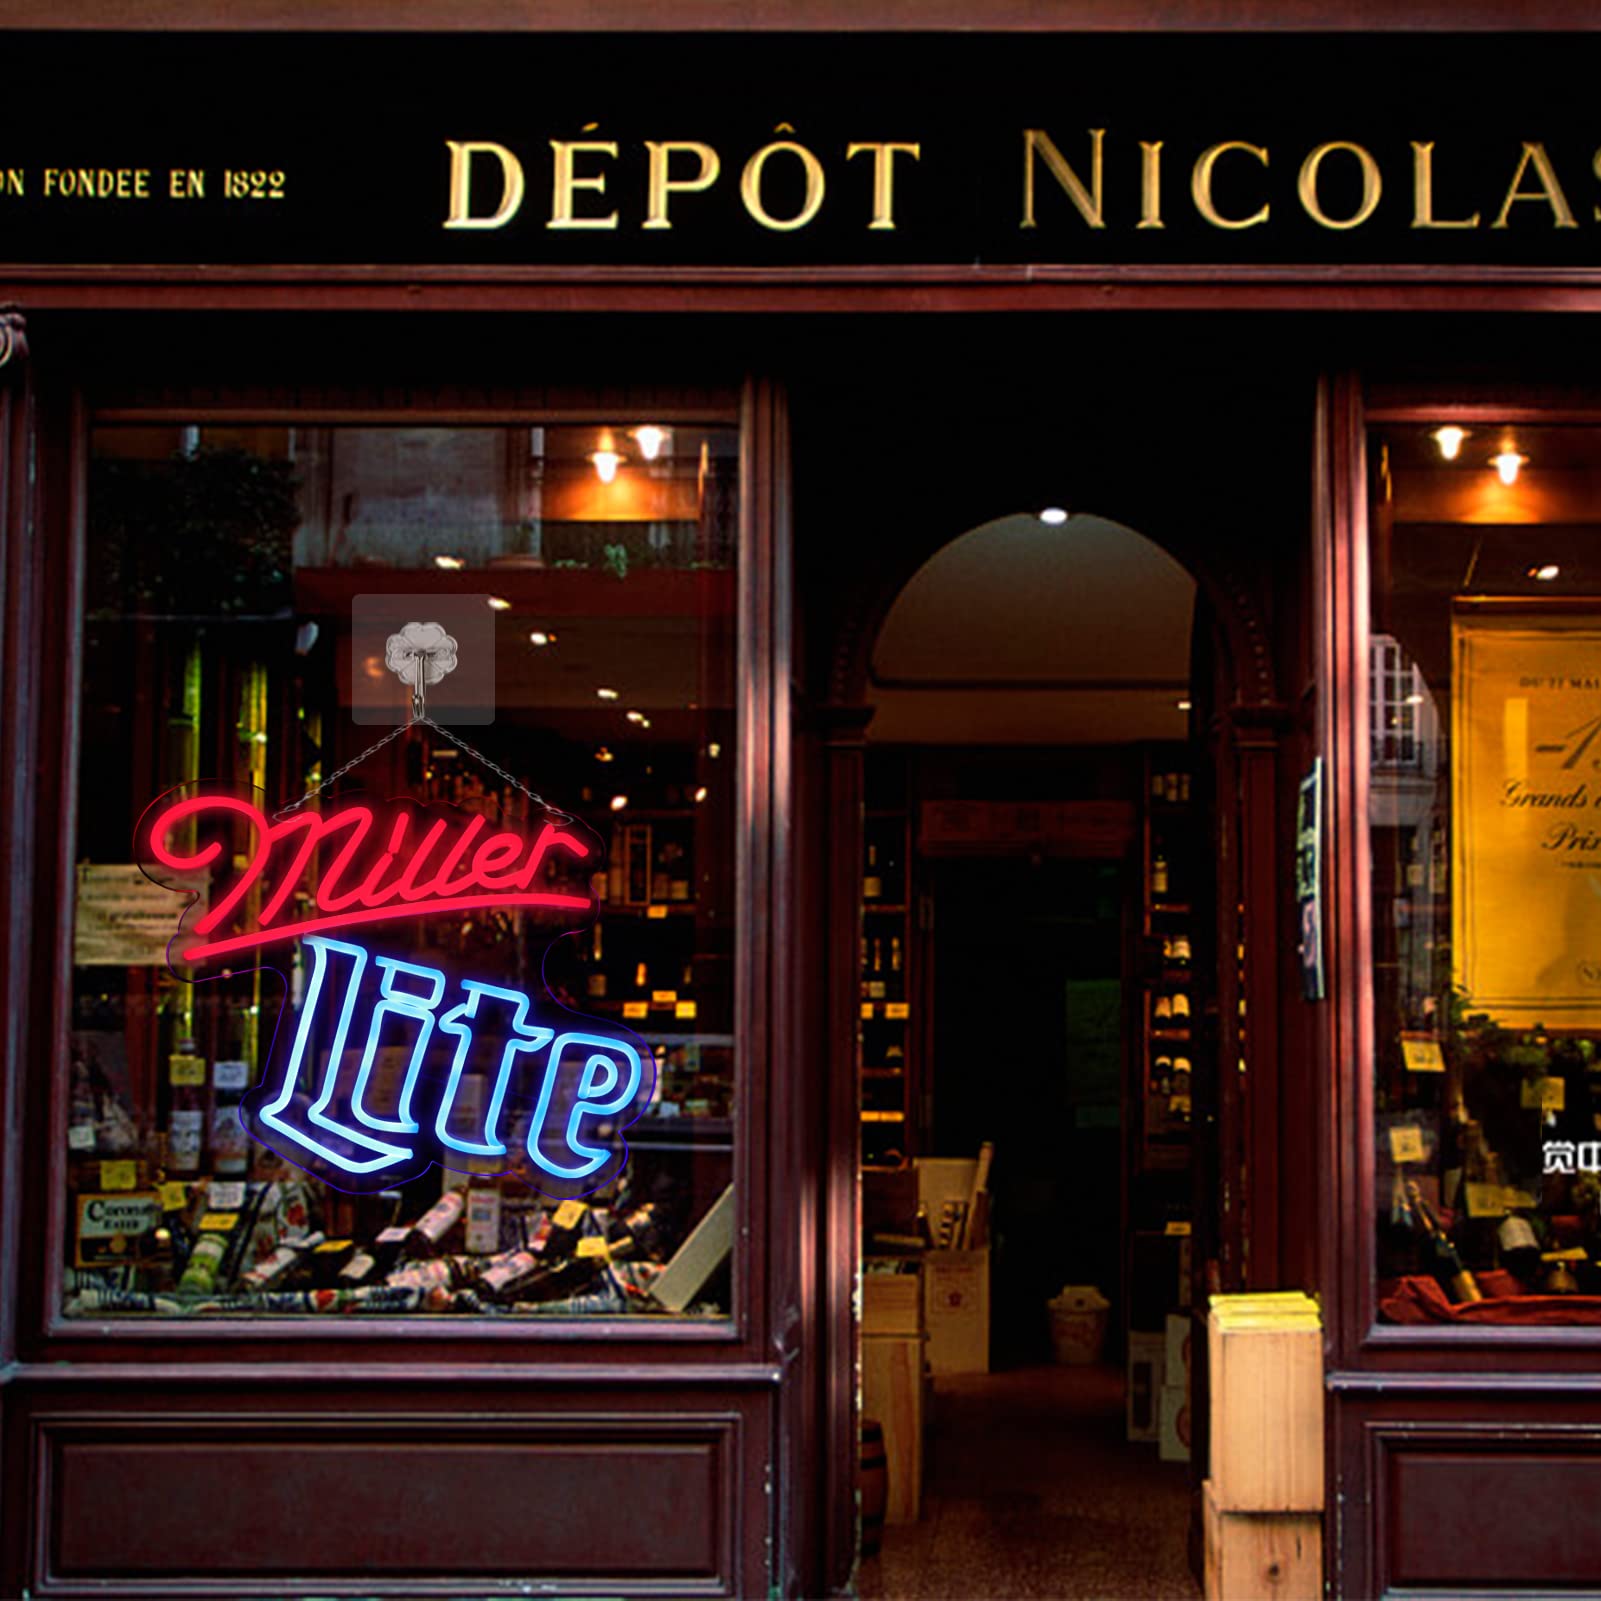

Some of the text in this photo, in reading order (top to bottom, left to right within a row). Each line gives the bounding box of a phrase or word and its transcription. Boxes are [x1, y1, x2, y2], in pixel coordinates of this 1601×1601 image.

[0, 169, 286, 198] N FONDEE EN 1822
[443, 123, 1601, 231] DÉPÔT NICOLA
[1501, 779, 1588, 808] Grands
[150, 796, 590, 936] Miller
[259, 935, 642, 1180] Lite
